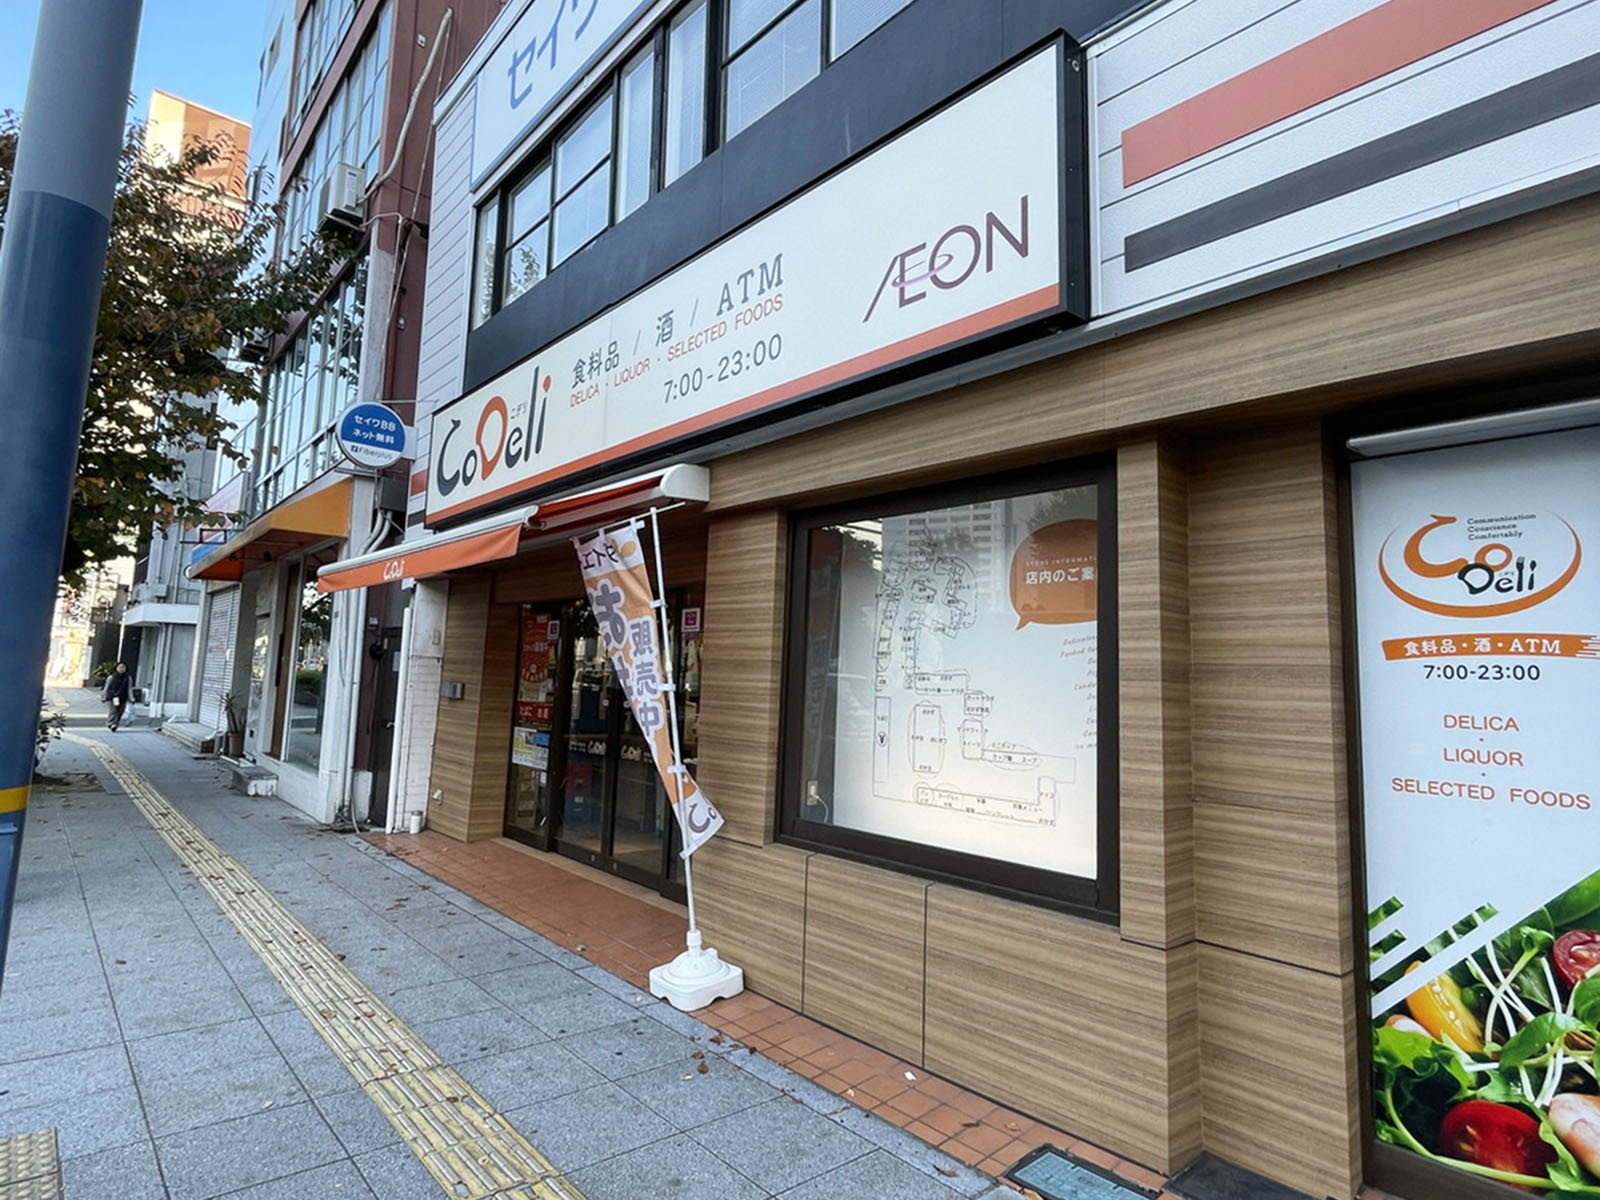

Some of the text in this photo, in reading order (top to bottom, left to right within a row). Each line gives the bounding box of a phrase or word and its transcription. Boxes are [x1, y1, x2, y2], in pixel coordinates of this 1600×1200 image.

[571, 340, 620, 389] 食料品
[655, 309, 675, 347] 酒
[716, 253, 784, 317] ATM
[569, 293, 783, 407] DELICA LIQUOR SELECTED FOODS
[663, 333, 782, 404] 7:00-23:00
[354, 414, 397, 433] セイワBB
[352, 428, 395, 445] ネット無料
[1467, 512, 1537, 525] Communication
[1467, 523, 1517, 533] Conscience
[1468, 531, 1523, 541] Comfortably
[1423, 664, 1541, 681] 7:00-23:00
[1443, 714, 1520, 732] DELICA
[1443, 747, 1524, 767] LIQUOR
[1391, 777, 1592, 811] SELECTED FOODS
